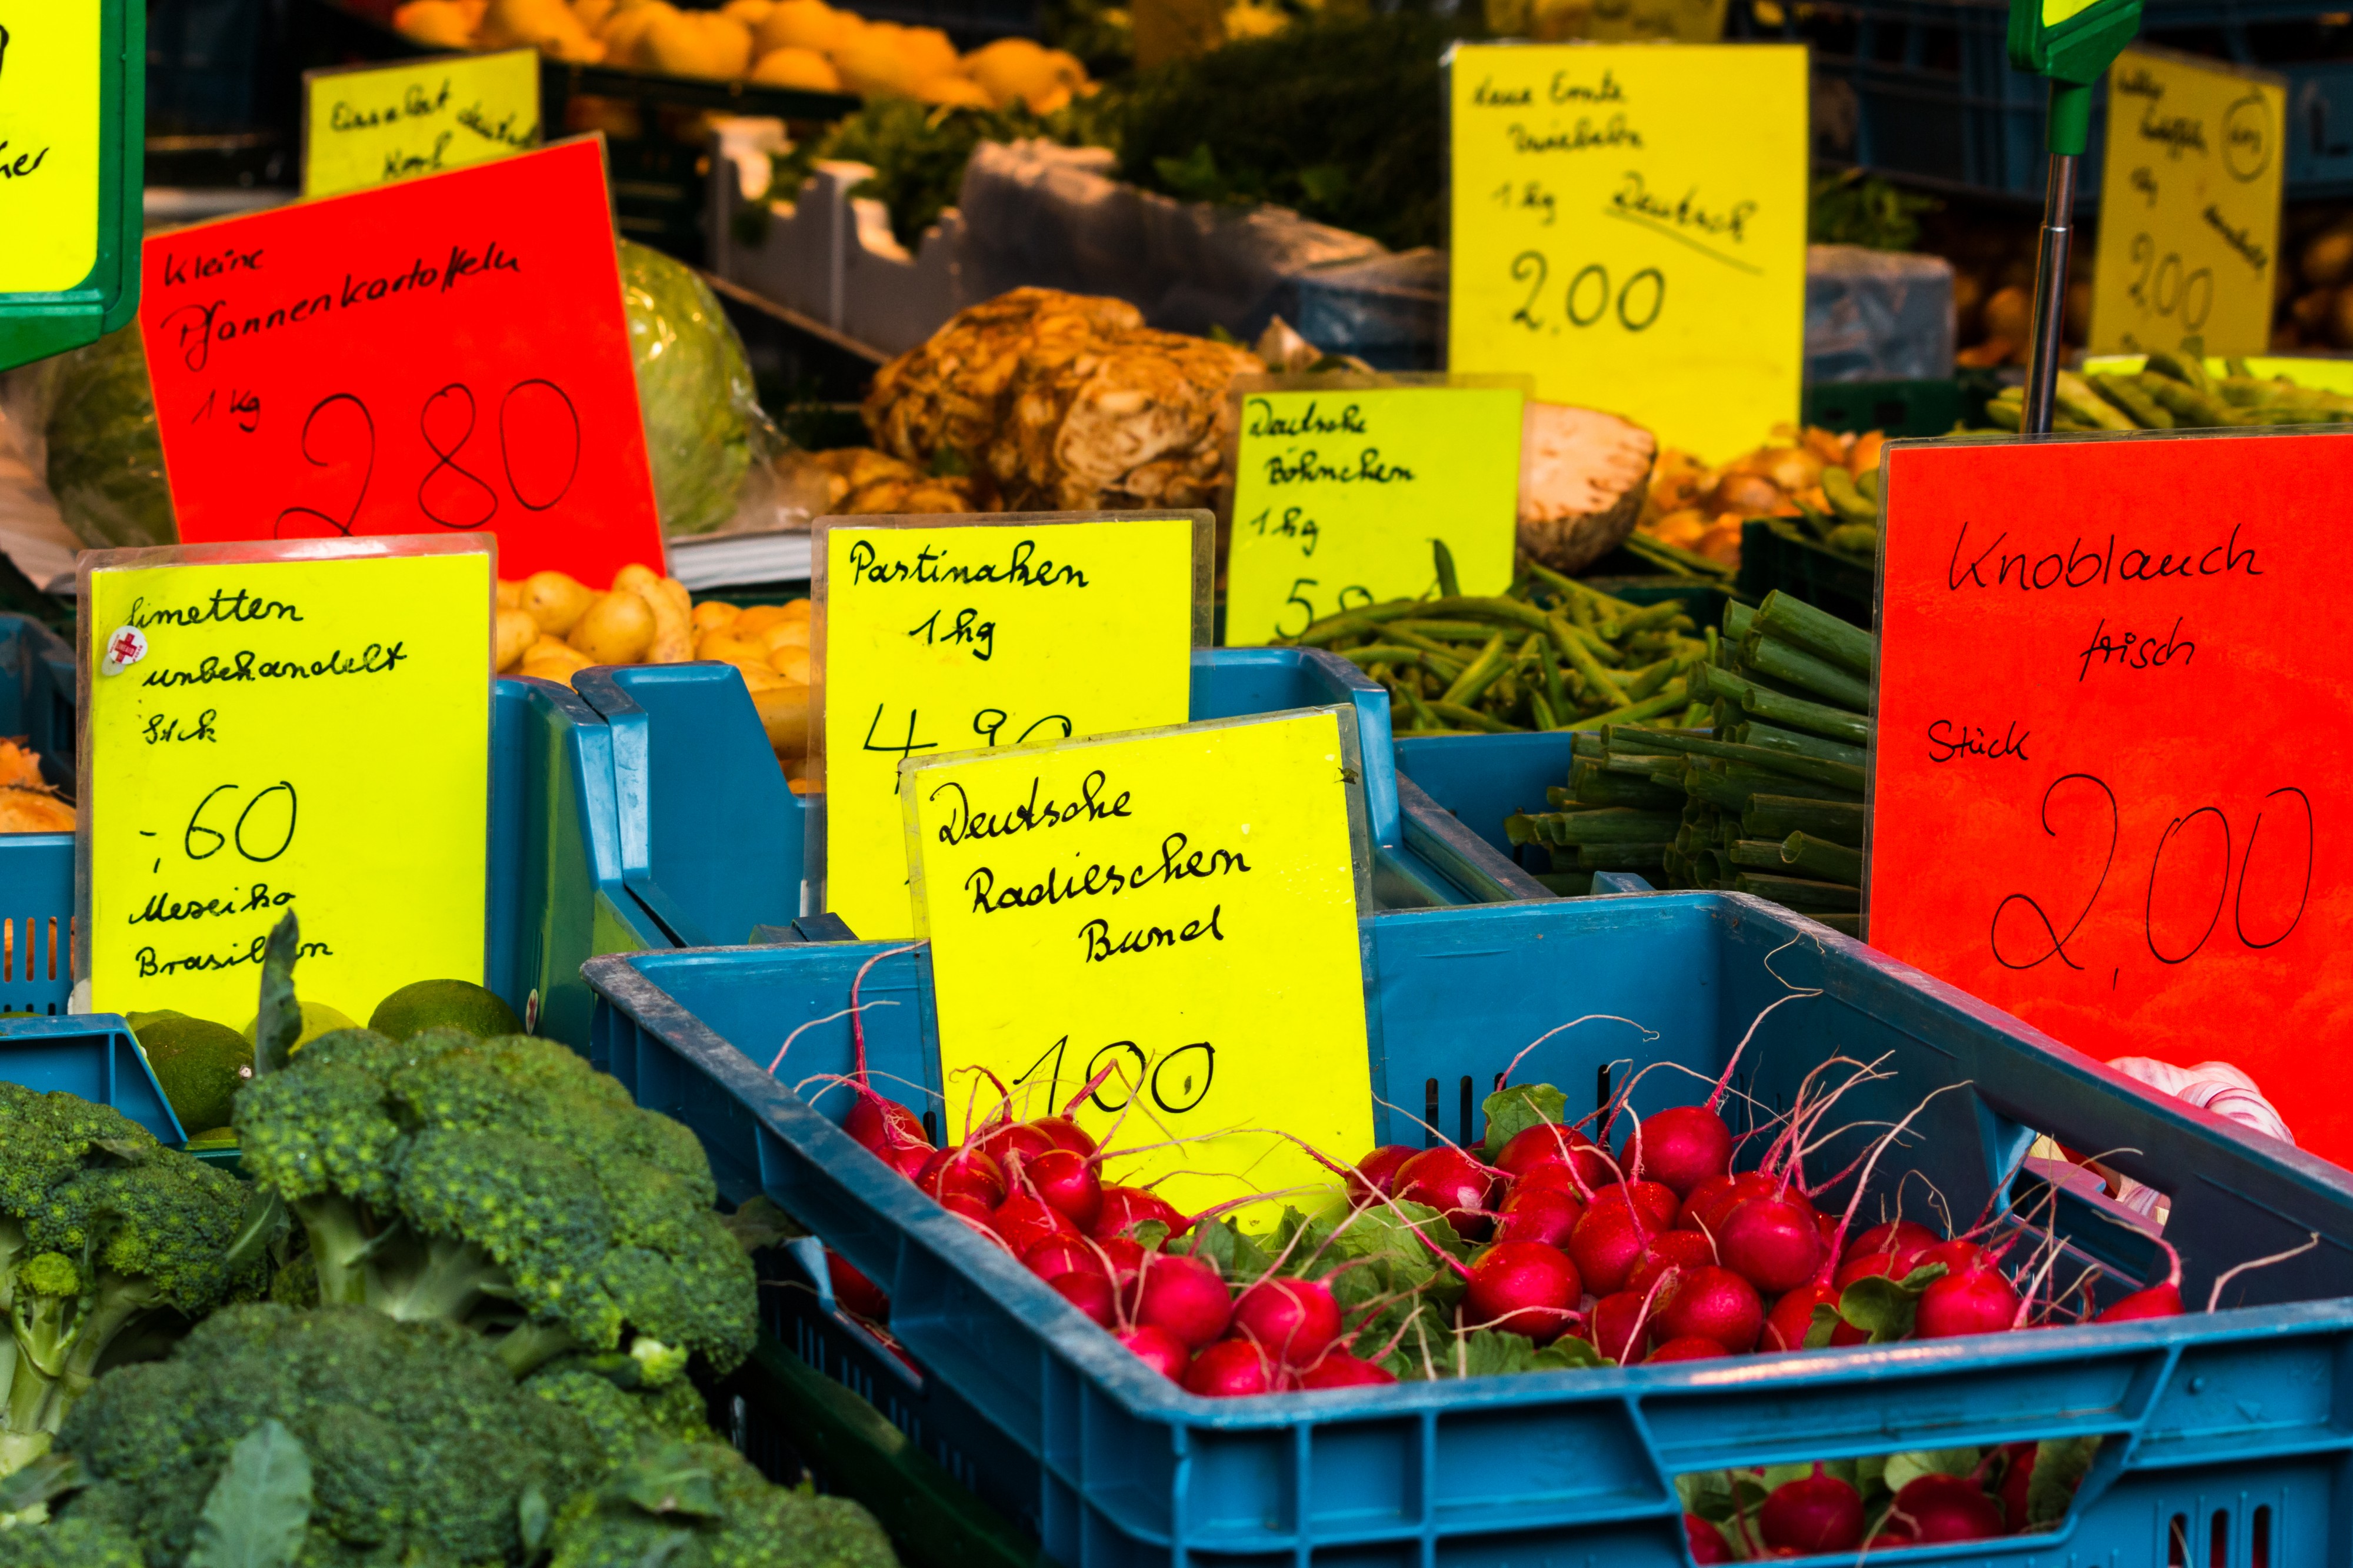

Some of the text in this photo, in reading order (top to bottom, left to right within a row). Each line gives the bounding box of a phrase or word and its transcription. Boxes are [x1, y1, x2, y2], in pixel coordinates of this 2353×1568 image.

[0, 140, 50, 179] er
[1491, 180, 1511, 208] 1
[161, 241, 521, 372] Pfannenkartoffeln
[191, 389, 216, 425] 1
[1264, 445, 1417, 486] Böhnchen
[1251, 506, 1319, 557] 1 kg
[1949, 521, 2264, 591] Knoblauch
[850, 539, 1089, 587] Pastinaken
[124, 588, 304, 629] Limetten
[909, 608, 996, 661] 1 kg
[2079, 616, 2195, 682] frisch
[142, 641, 407, 688] unbehandelt
[1928, 719, 2029, 763] Stück
[929, 769, 1133, 845] Deutsche
[965, 832, 1251, 914] Radieschen
[1991, 772, 2314, 992] 2,00
[1078, 905, 1225, 963] Bund
